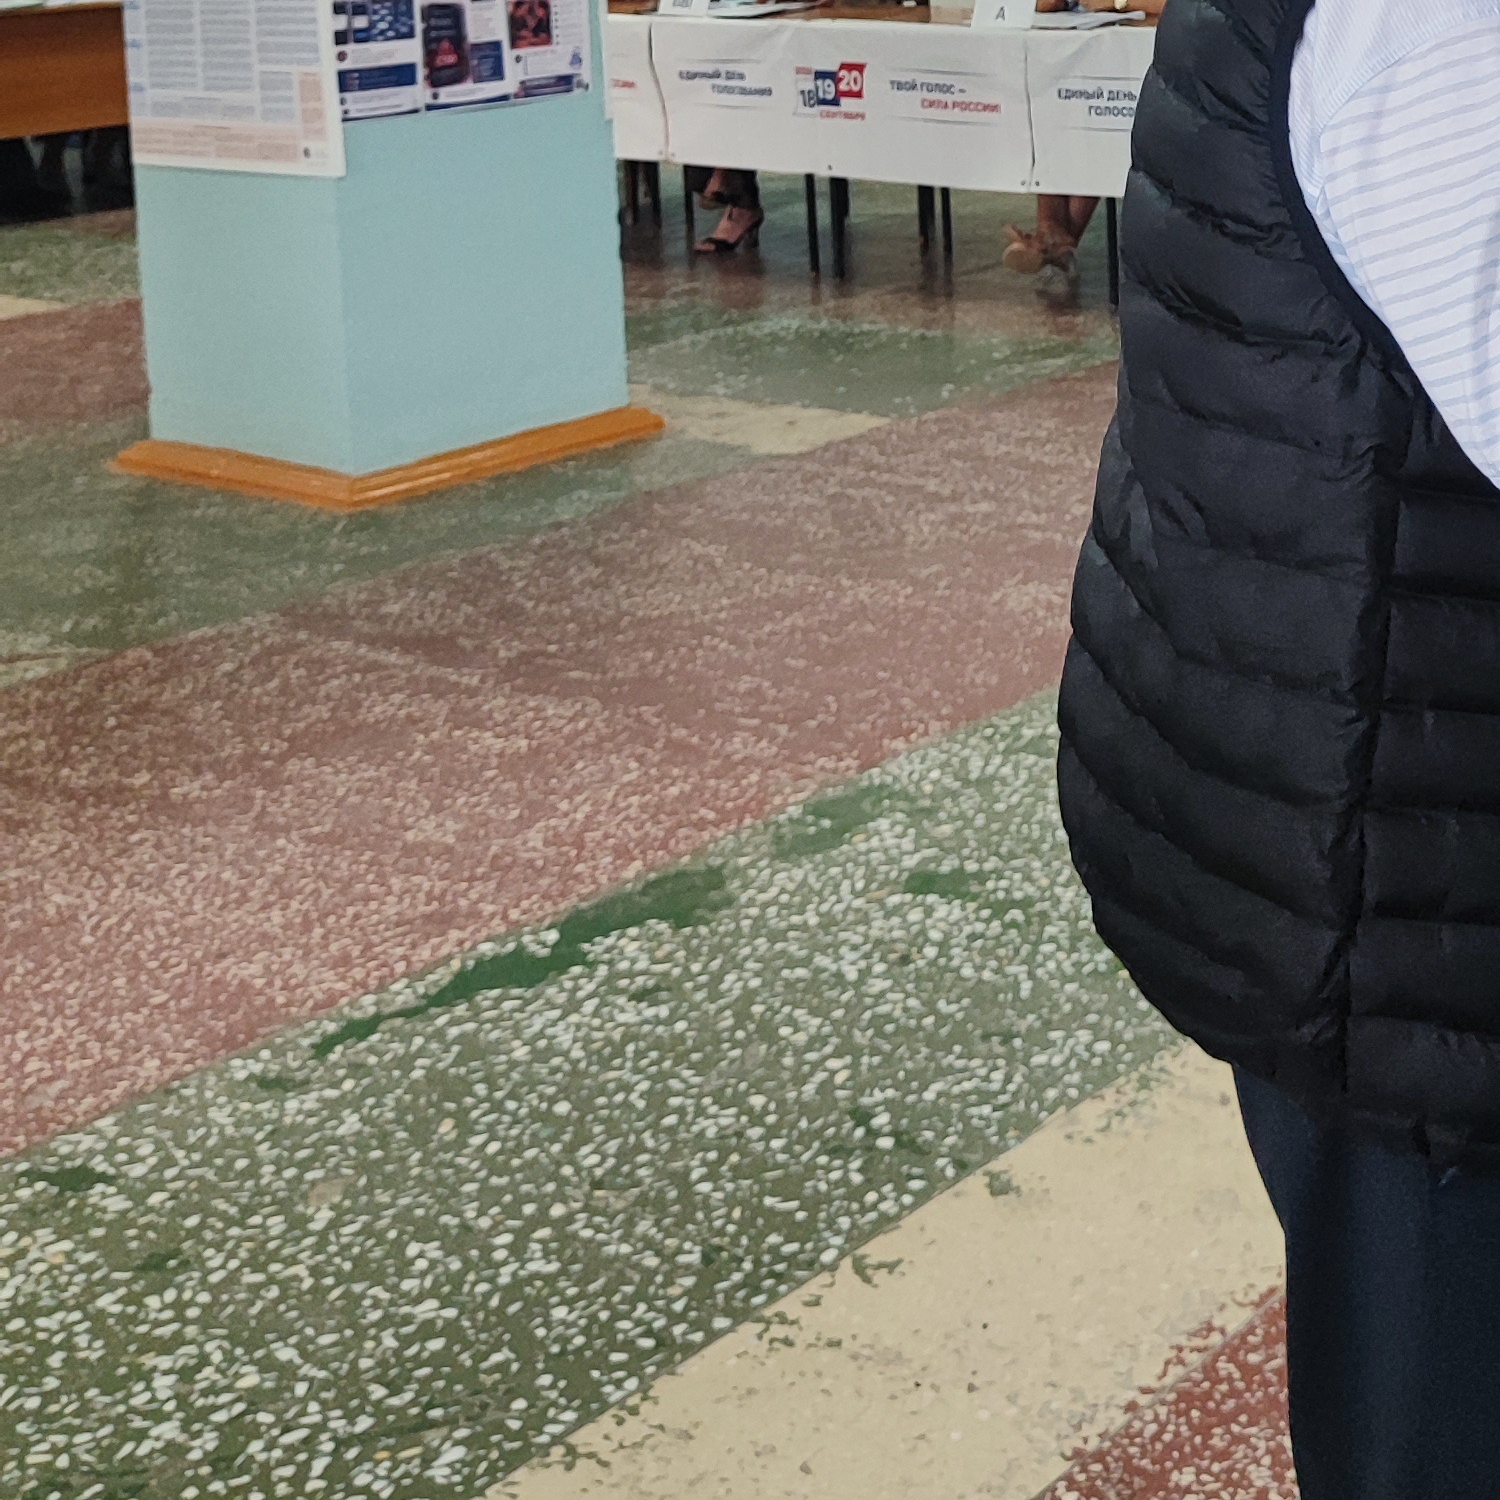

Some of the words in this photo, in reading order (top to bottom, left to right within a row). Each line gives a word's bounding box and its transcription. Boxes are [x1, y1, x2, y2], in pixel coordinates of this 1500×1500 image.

[995, 5, 1006, 21] А
[815, 78, 837, 101] 19
[838, 68, 863, 92] 20
